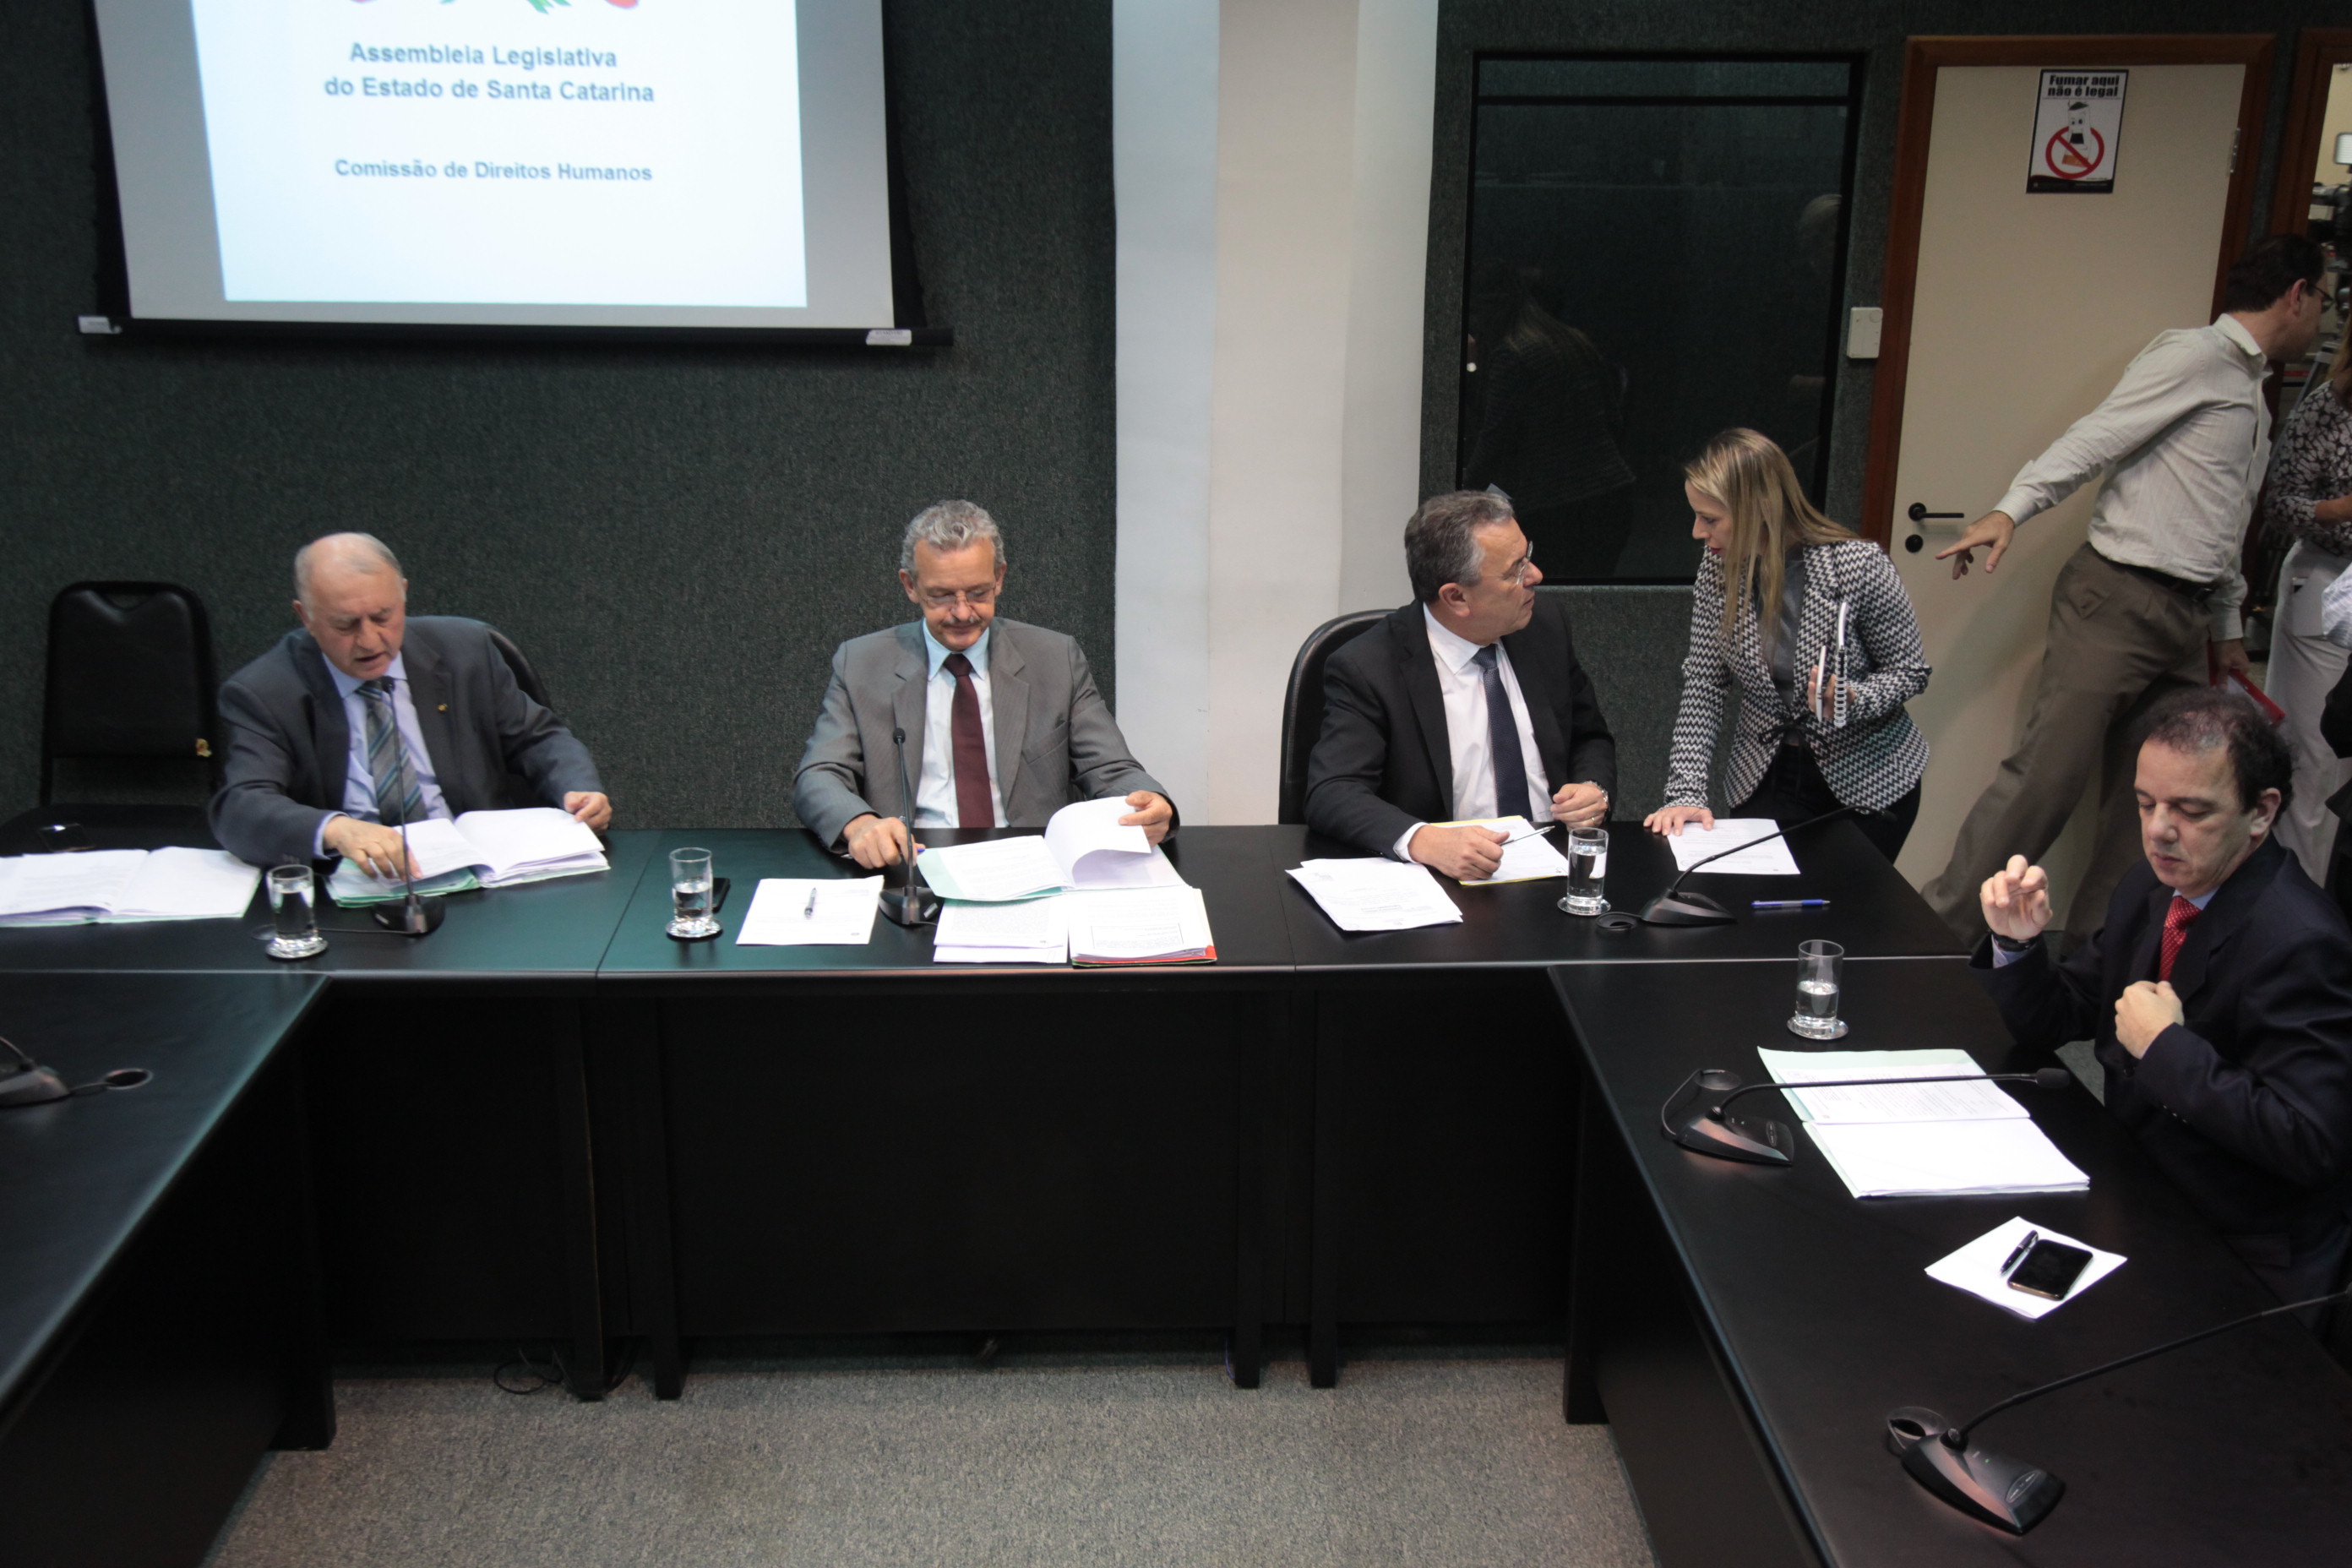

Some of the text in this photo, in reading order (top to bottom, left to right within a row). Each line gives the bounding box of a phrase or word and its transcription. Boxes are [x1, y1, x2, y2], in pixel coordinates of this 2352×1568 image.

[348, 41, 618, 72] Assembleia Legislativa
[323, 75, 655, 102] do Estado de Santa Catarina
[2047, 85, 2118, 98] não é legal
[2049, 74, 2120, 87] Fumar aqui
[334, 158, 653, 182] Comissão de Direitos Humanos
